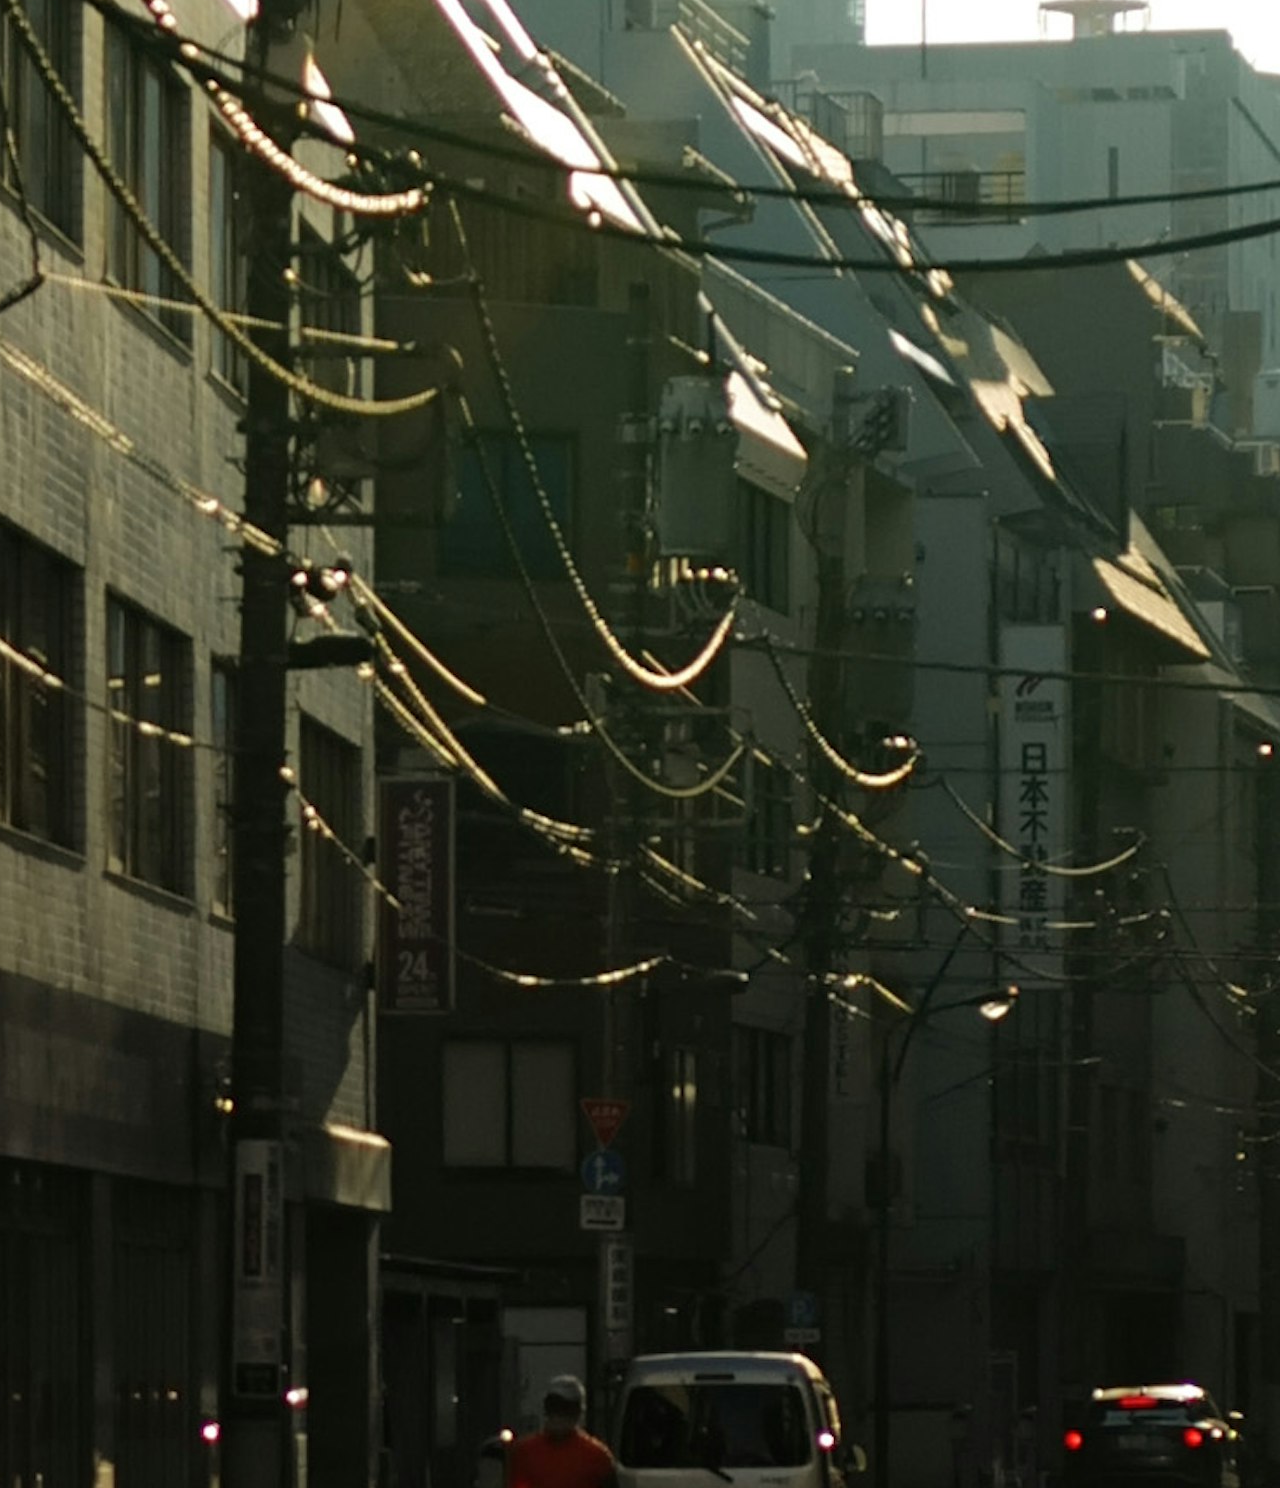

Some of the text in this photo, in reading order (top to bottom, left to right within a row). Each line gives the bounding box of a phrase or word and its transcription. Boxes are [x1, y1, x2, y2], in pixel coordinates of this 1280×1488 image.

[1019, 743, 1048, 912] 日本不動産
